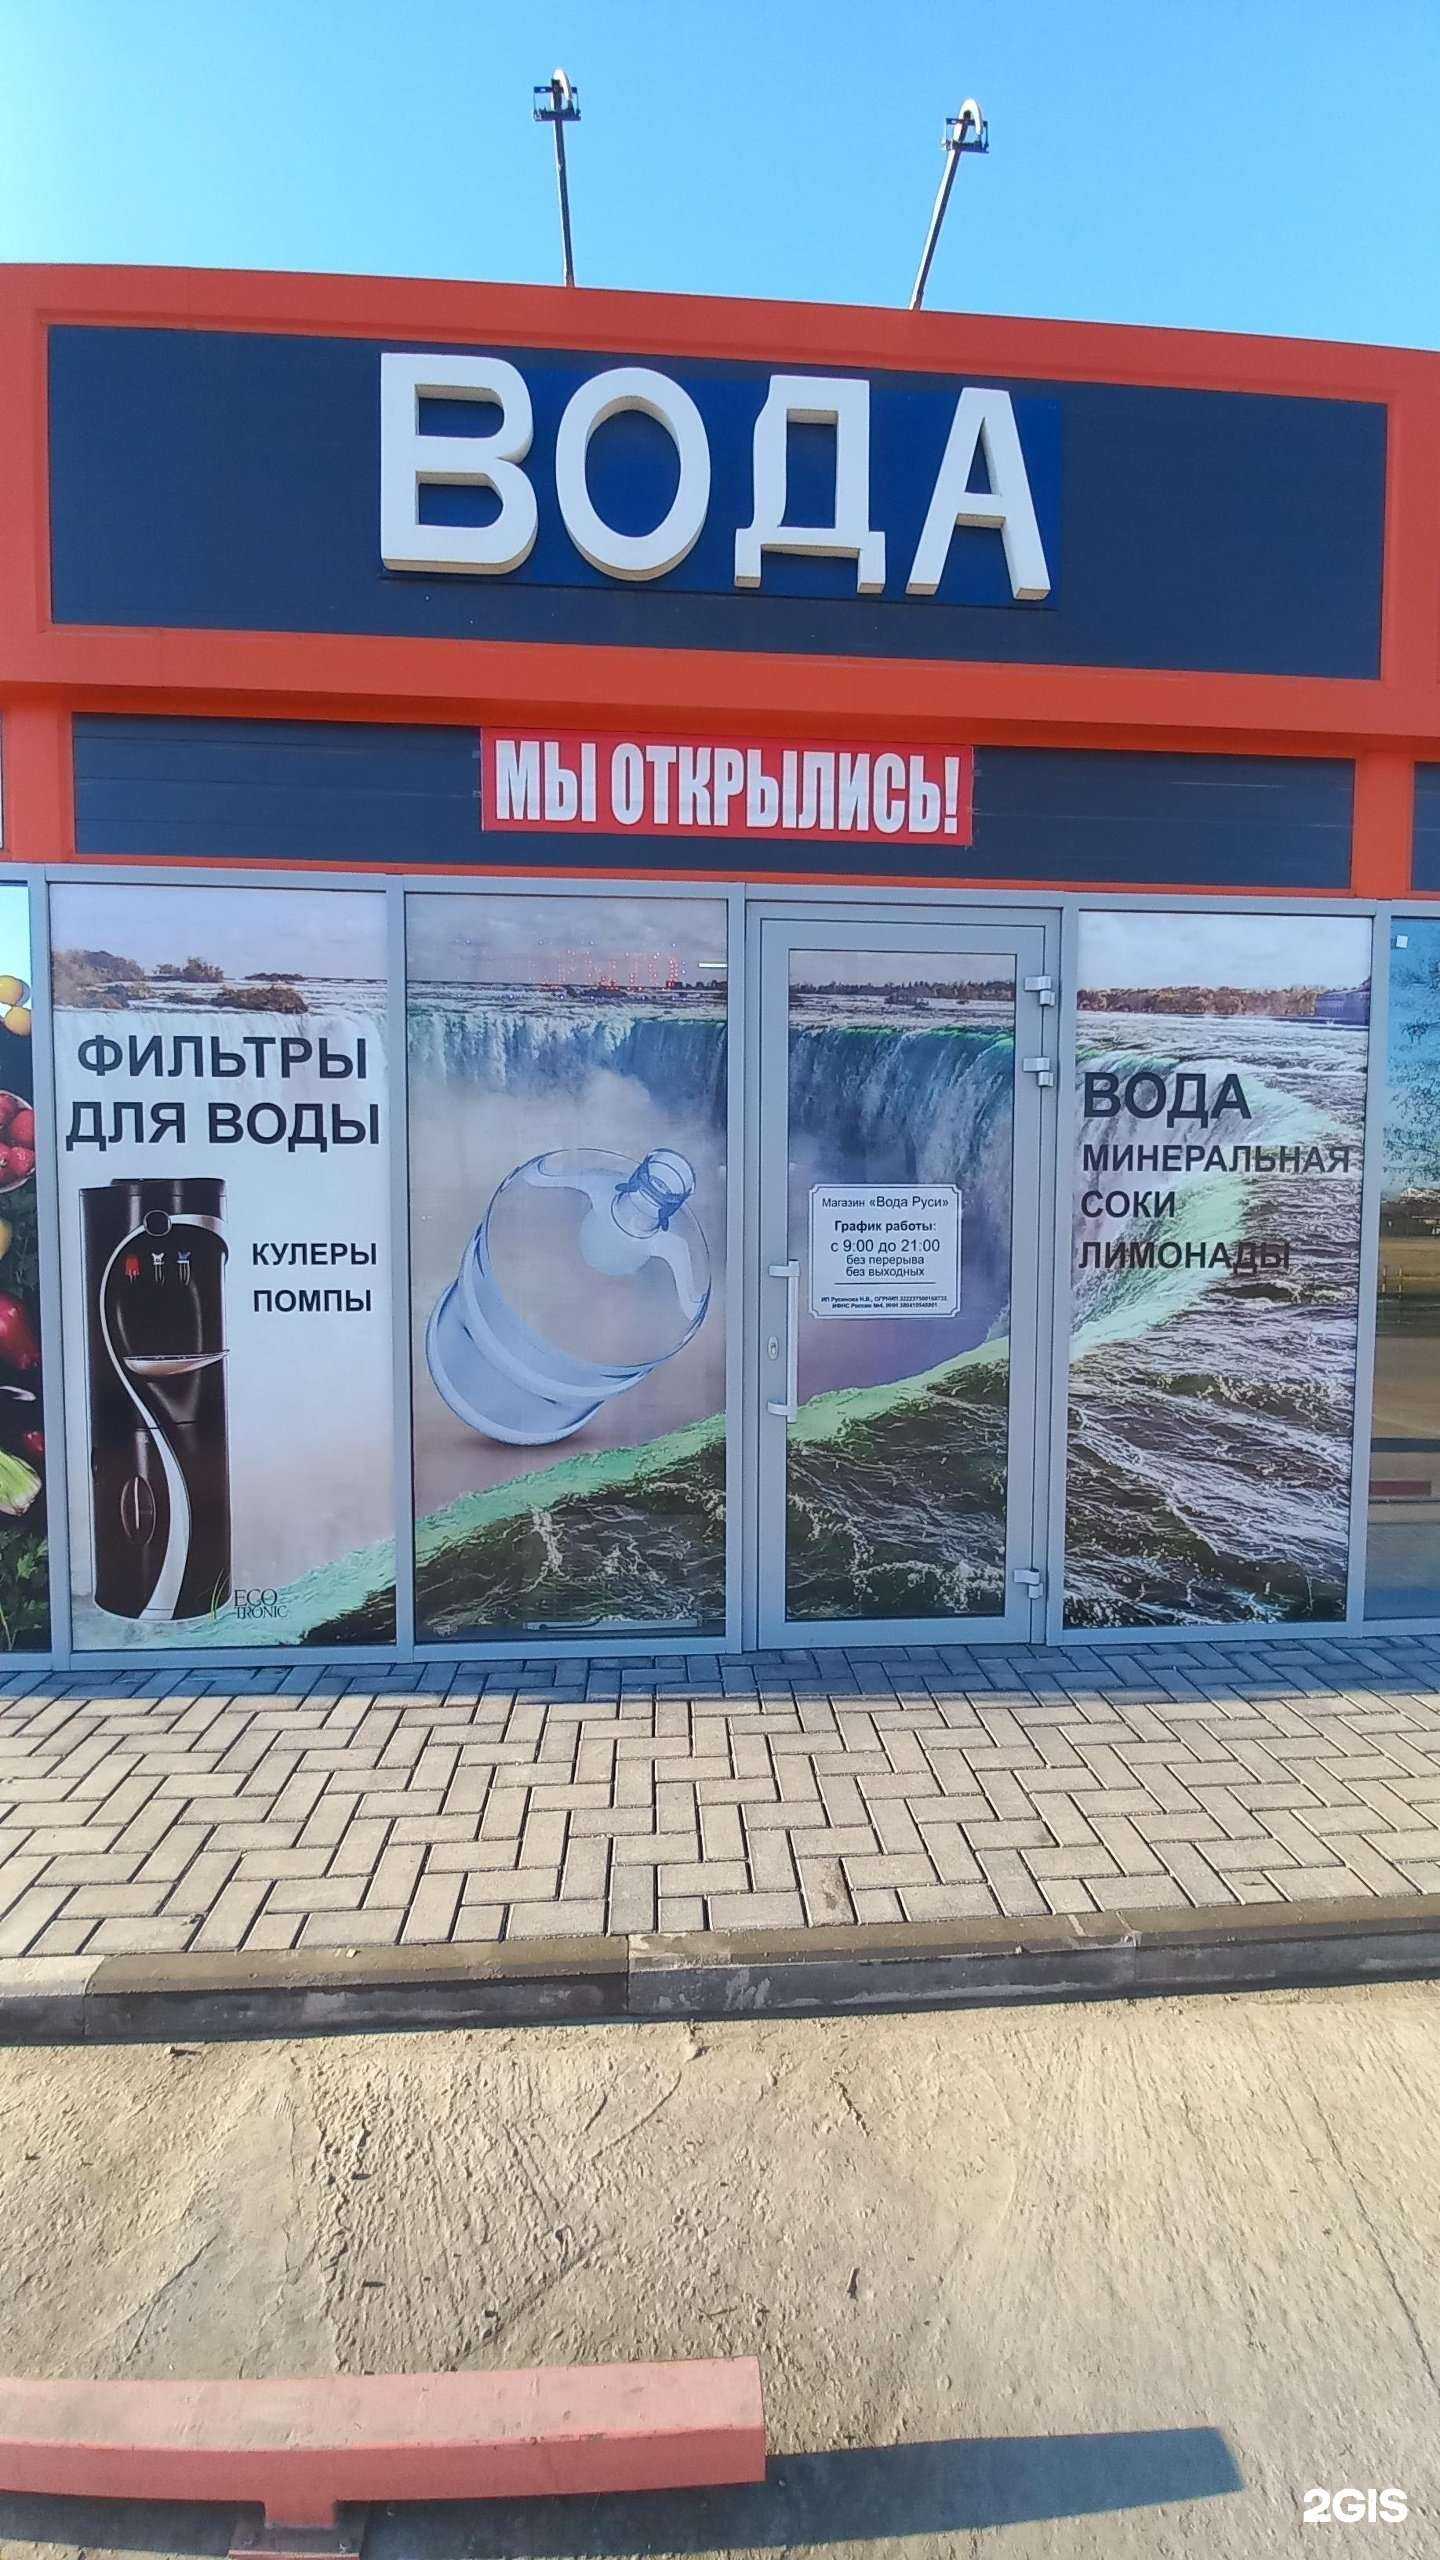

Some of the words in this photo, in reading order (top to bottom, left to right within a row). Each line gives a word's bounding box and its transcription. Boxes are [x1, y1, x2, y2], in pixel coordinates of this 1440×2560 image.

[381, 352, 1052, 601] ВОДА
[495, 739, 597, 822] МЫ
[611, 743, 960, 834] ОТКРЫЛИСЬ!
[77, 1034, 367, 1079] ФИЛЬТРЫ
[1083, 1071, 1252, 1129] ВОДА
[66, 1101, 186, 1152] ДЛЯ
[208, 1102, 380, 1153] ВОДЫ
[1082, 1144, 1350, 1173] МИНЕРАЛЬНАЯ
[822, 1197, 865, 1208] Магазин
[869, 1196, 908, 1210] «Вода
[912, 1196, 949, 1210] Руси»
[1080, 1190, 1176, 1218] СОКИ
[834, 1220, 882, 1233] График
[885, 1220, 937, 1233] работы:
[252, 1242, 377, 1266] КУЛЕРЫ
[831, 1242, 839, 1252] с
[843, 1239, 874, 1252] 9:00
[878, 1242, 897, 1254] до
[901, 1239, 940, 1252] 21:00
[1078, 1241, 1290, 1275] ЛИМОНАДЫ
[846, 1254, 866, 1265] без
[868, 1256, 925, 1267] перерыва
[846, 1266, 865, 1277] без
[868, 1267, 925, 1278] выходных
[253, 1289, 372, 1312] ПОМПЫ
[233, 1588, 278, 1607] ECO
[234, 1605, 288, 1620] TRONIC
